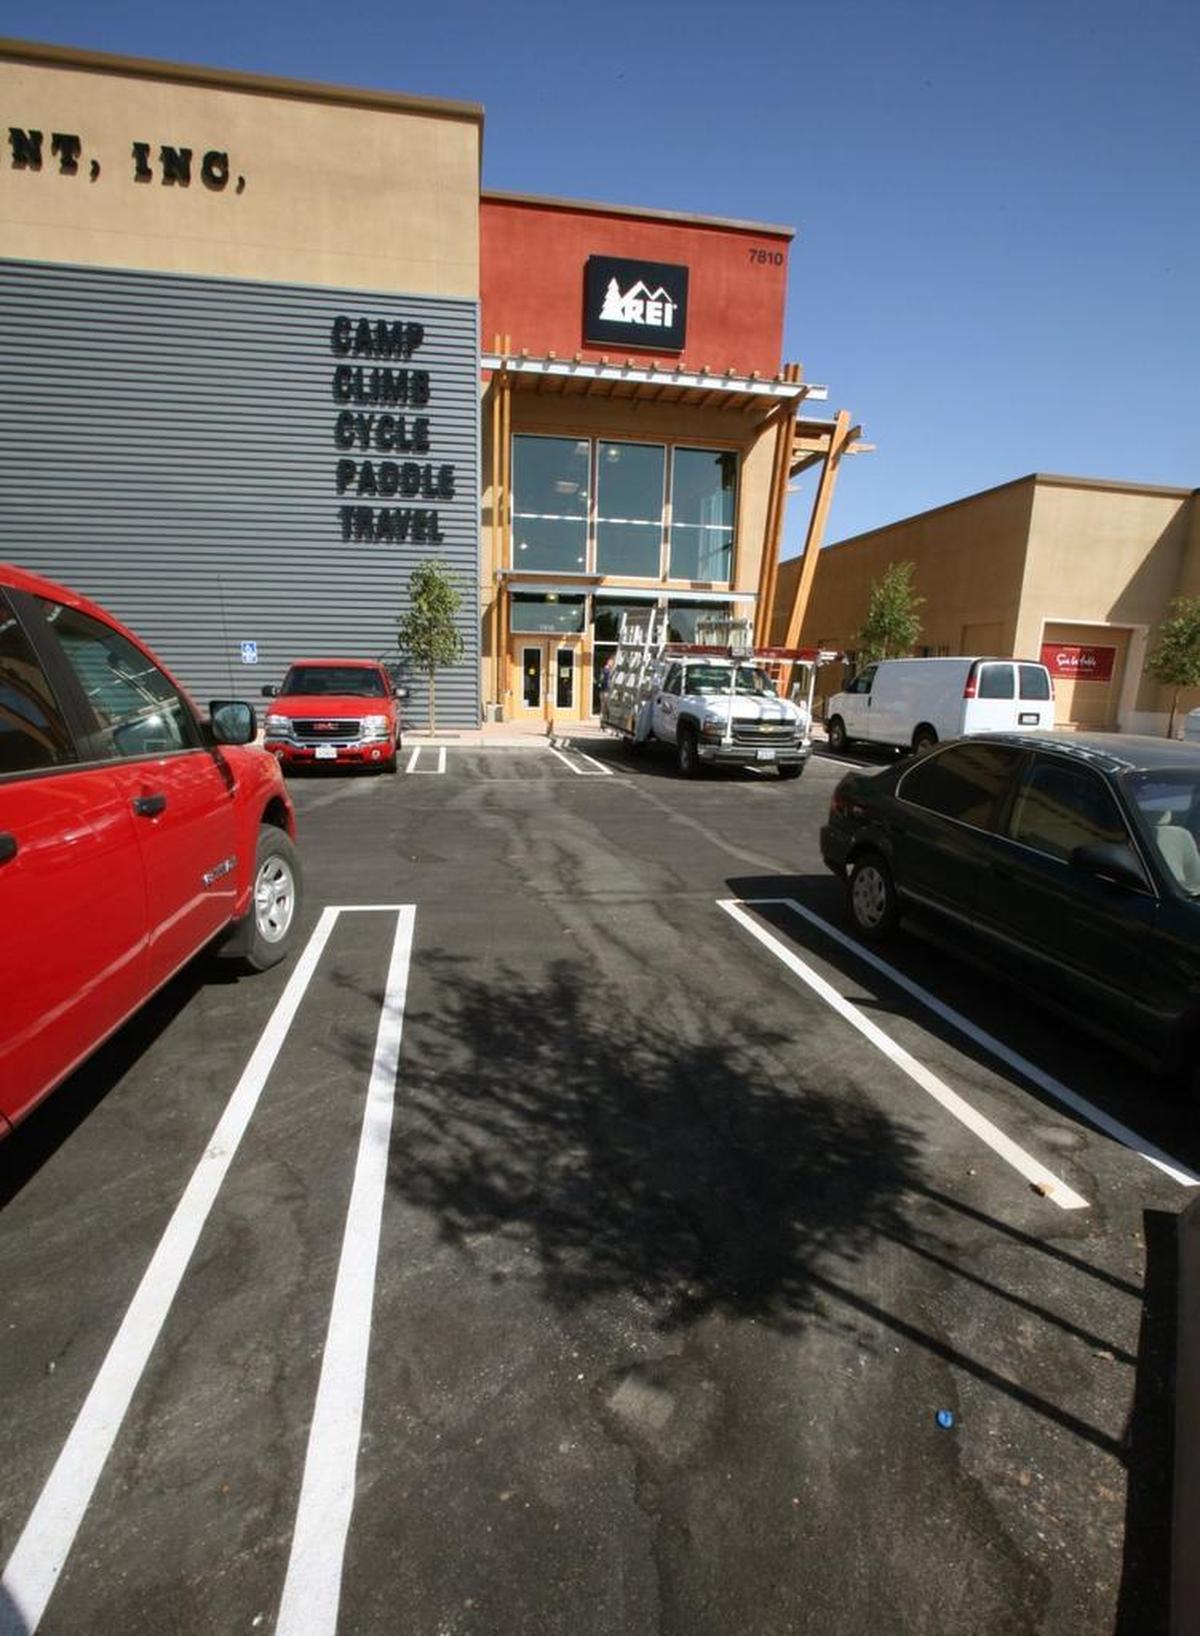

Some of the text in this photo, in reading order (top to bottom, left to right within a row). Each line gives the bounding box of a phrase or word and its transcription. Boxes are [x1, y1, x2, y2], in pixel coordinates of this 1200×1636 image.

[748, 248, 784, 266] 7810
[330, 316, 424, 361] CAMP
[332, 365, 431, 409] CLIMB
[334, 410, 430, 455] CYCLE
[336, 459, 455, 500] PADDLE
[338, 505, 445, 545] TRAVEL
